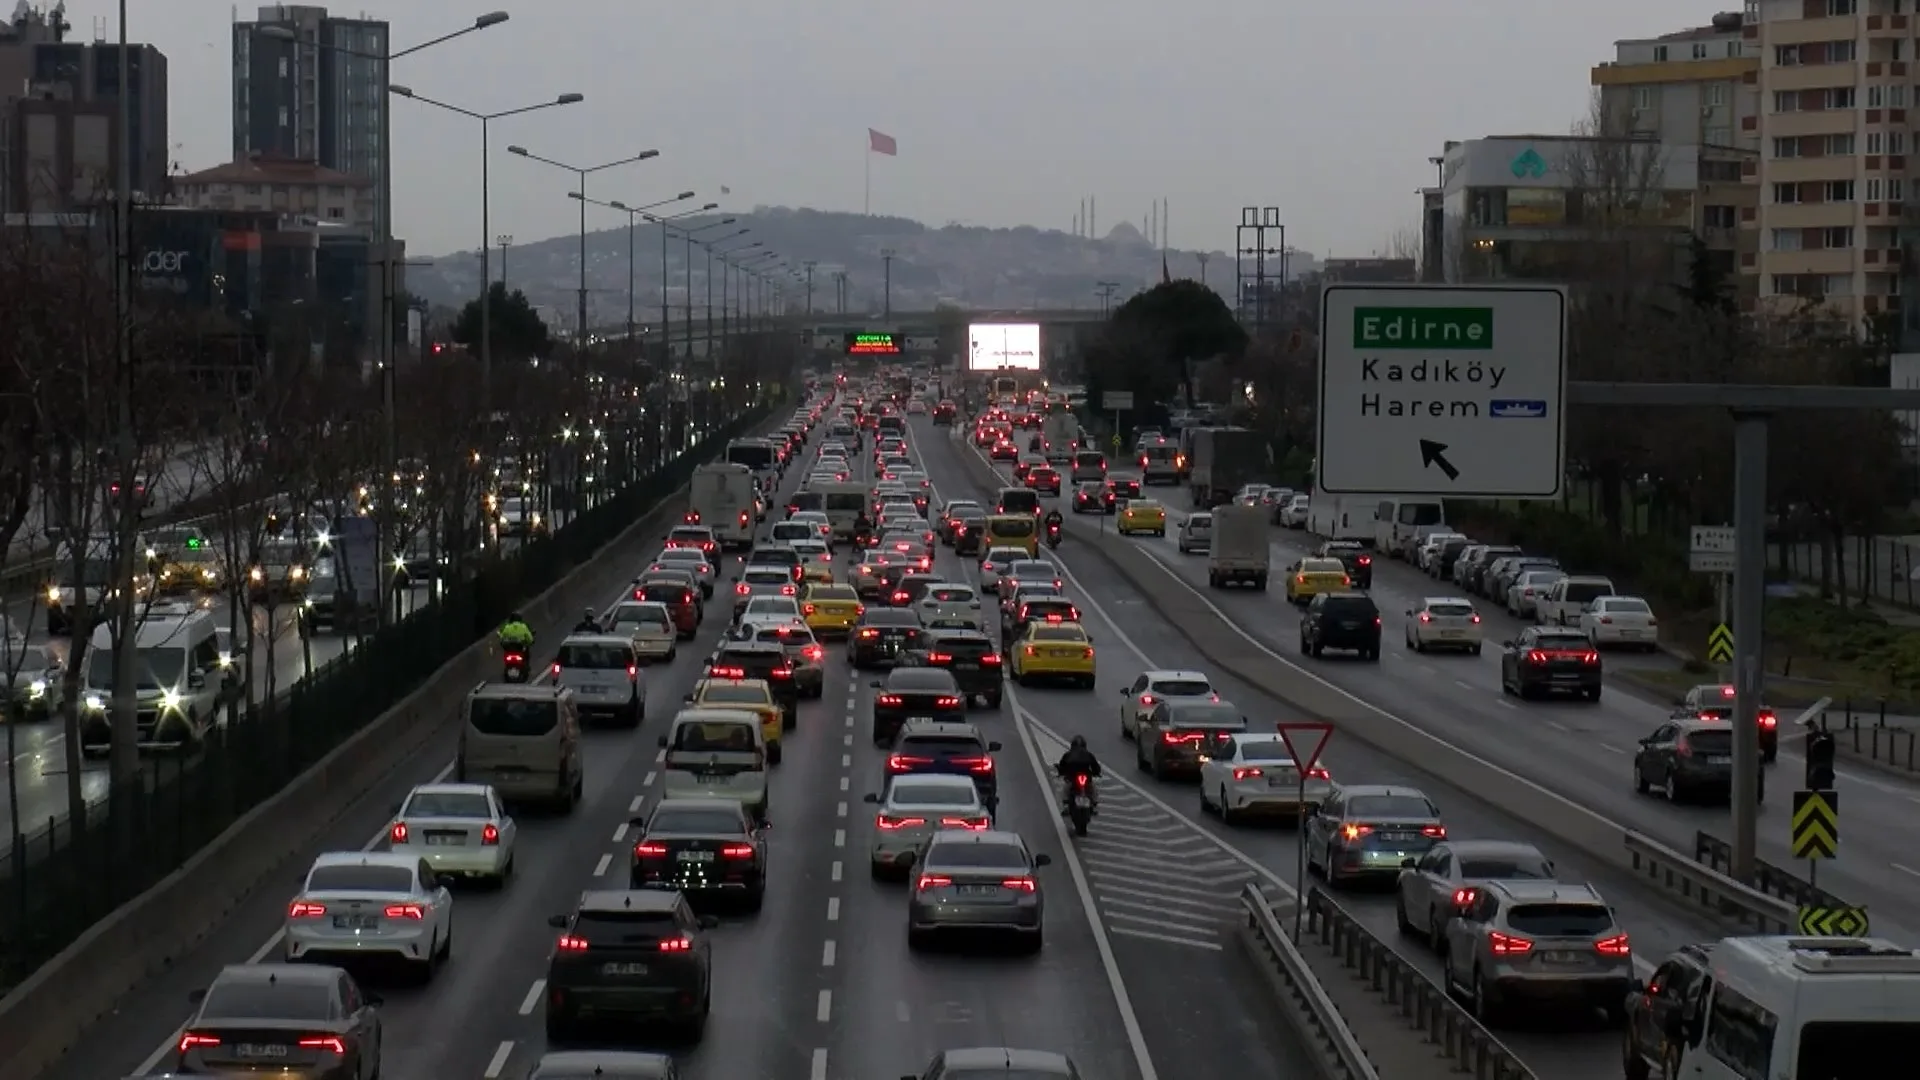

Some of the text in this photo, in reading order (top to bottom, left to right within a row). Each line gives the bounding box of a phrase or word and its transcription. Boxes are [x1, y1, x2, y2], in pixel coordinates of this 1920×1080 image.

[1362, 316, 1484, 340] Edirne
[1362, 358, 1506, 389] Kadıköy
[1361, 393, 1479, 417] Harem
